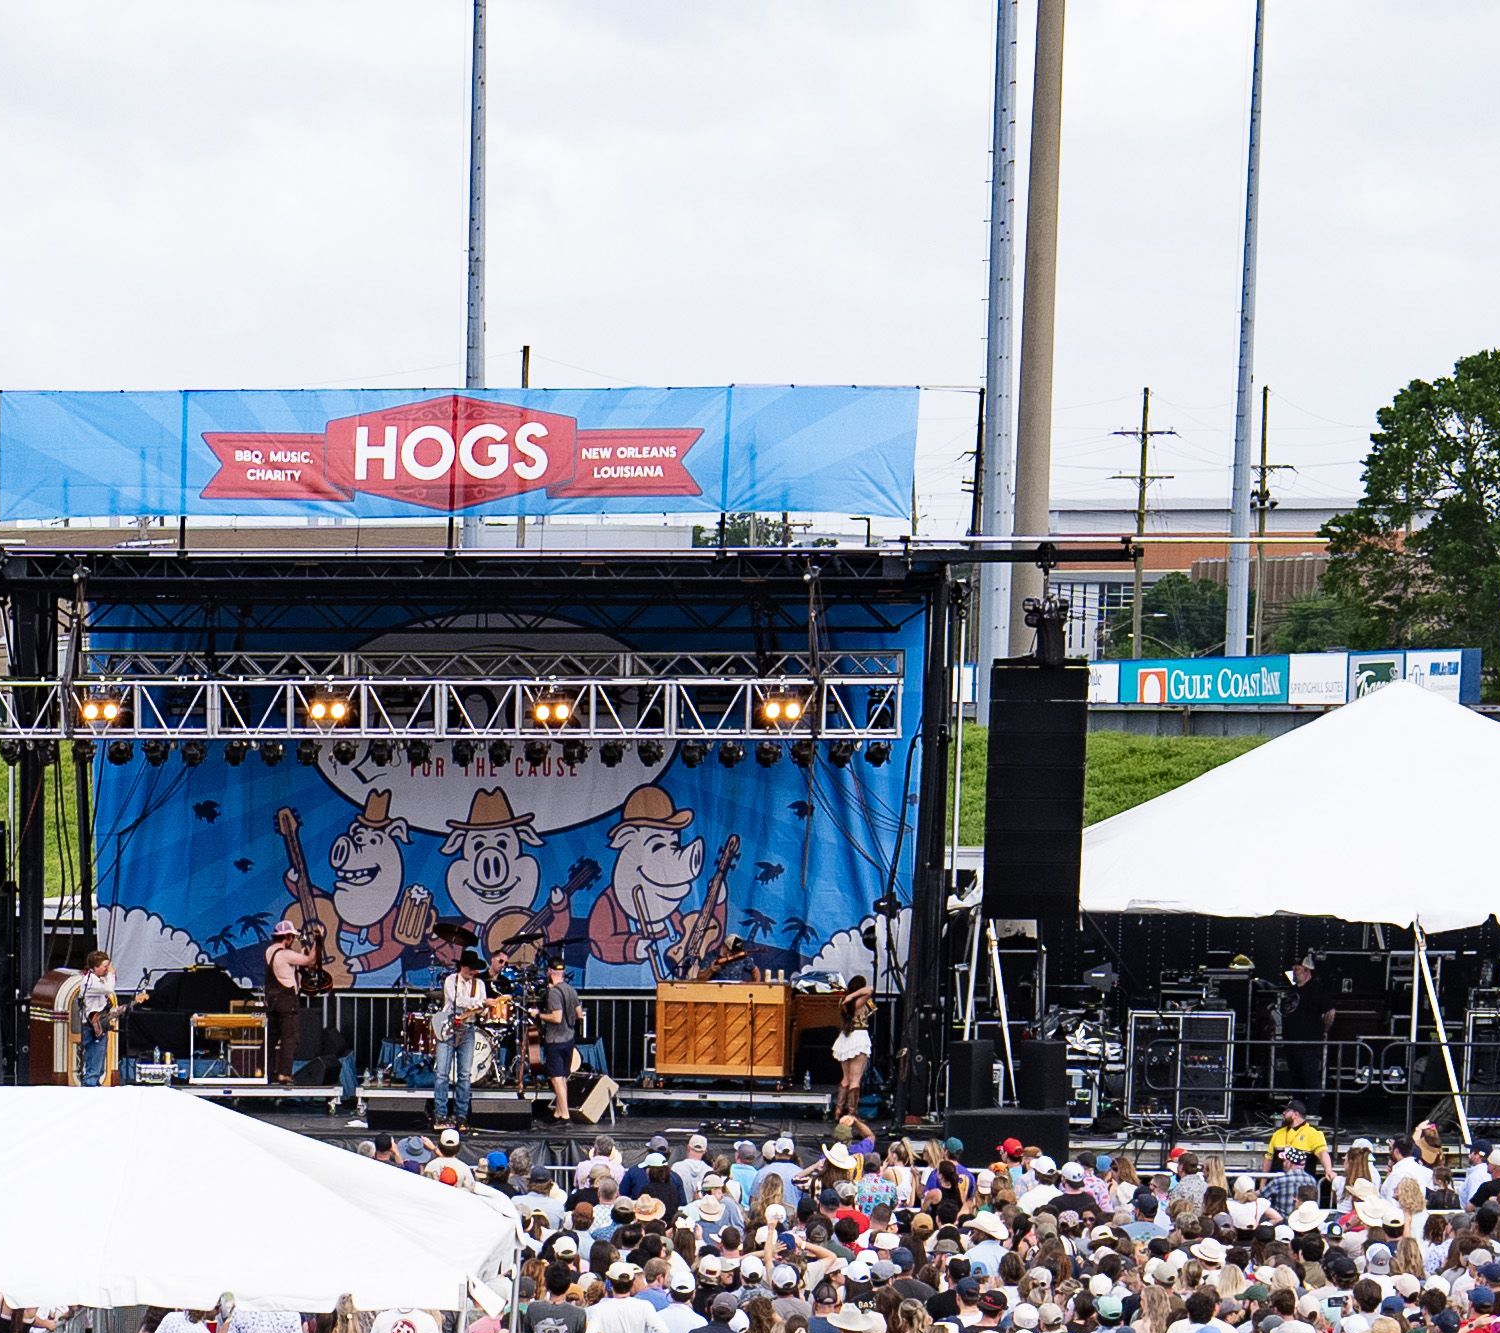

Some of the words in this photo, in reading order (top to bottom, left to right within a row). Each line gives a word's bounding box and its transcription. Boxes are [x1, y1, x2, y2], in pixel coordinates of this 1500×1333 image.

[354, 421, 549, 480] HOGS
[581, 447, 612, 460] NEW
[616, 446, 677, 459] ORLEANS
[247, 468, 301, 482] CHARITY
[593, 466, 663, 479] LOUISIANA
[514, 757, 578, 778] CAUSE
